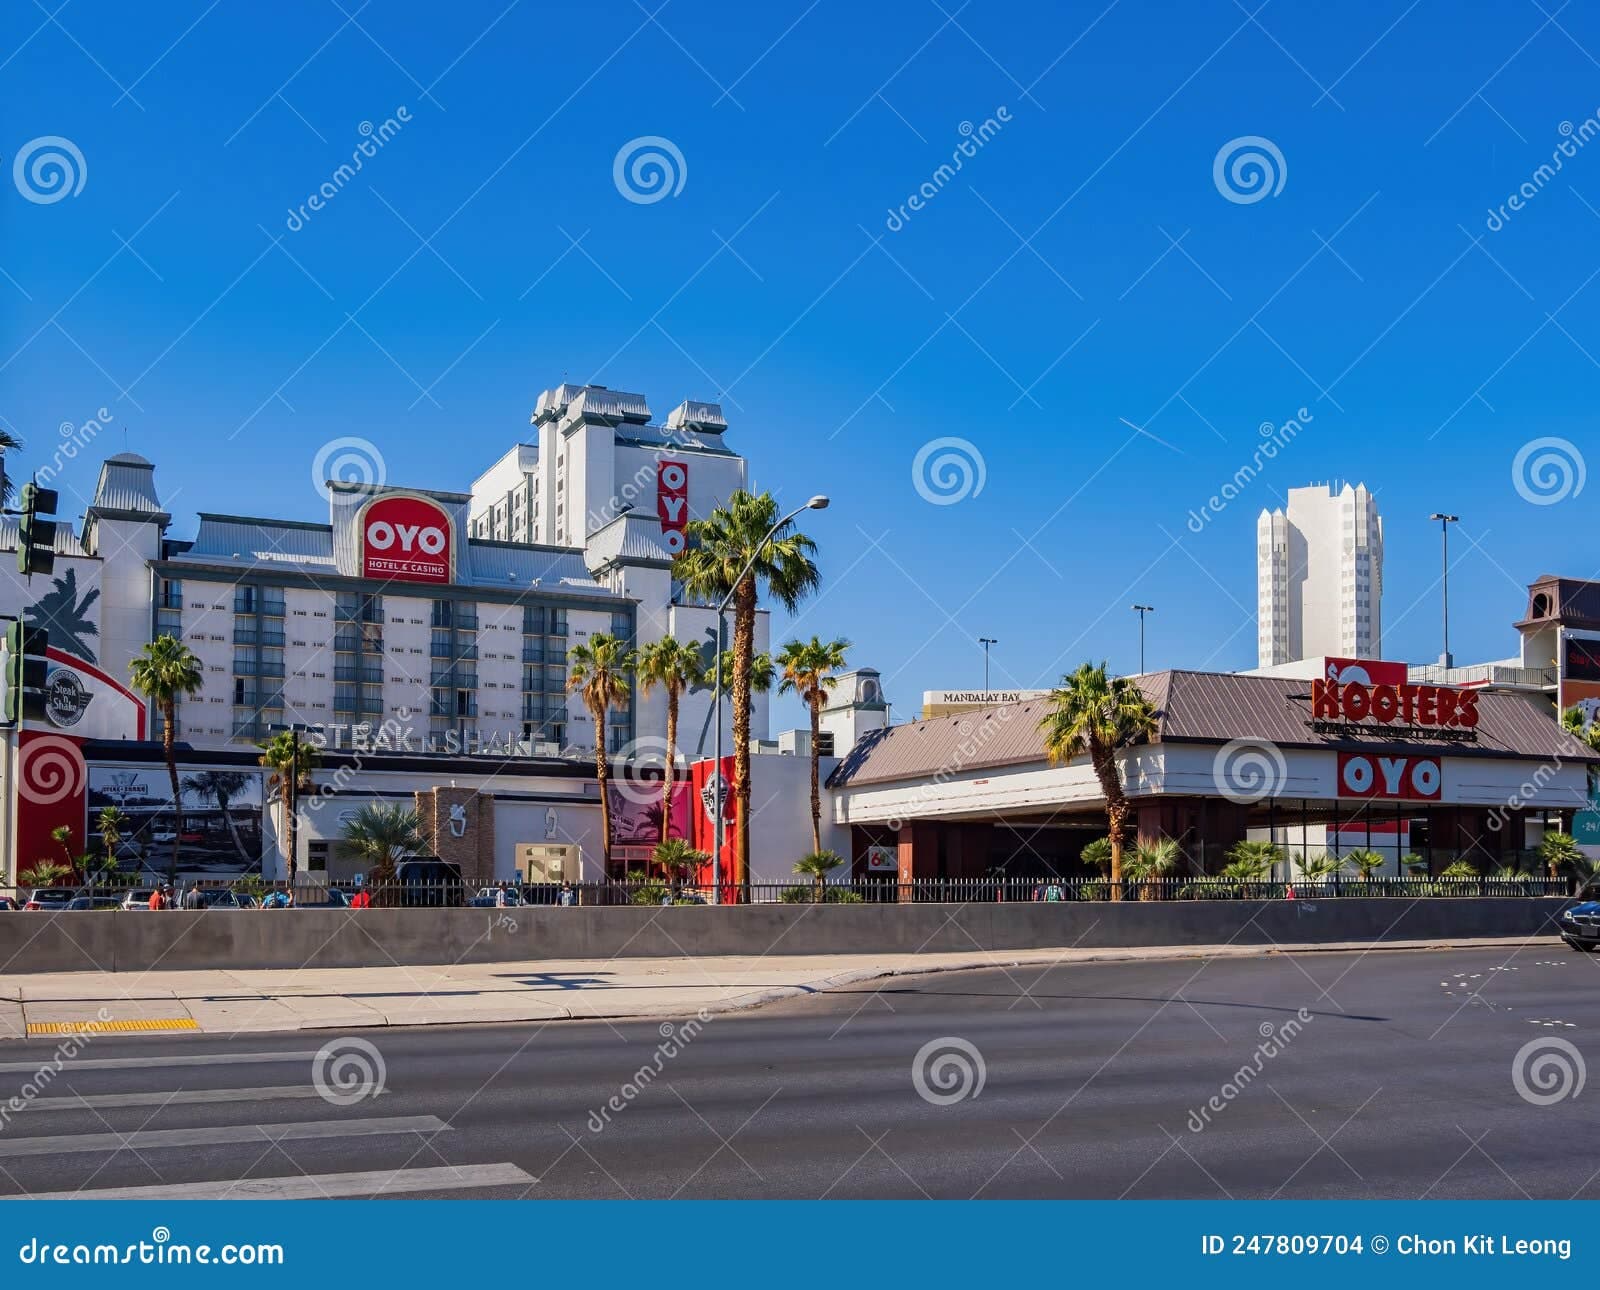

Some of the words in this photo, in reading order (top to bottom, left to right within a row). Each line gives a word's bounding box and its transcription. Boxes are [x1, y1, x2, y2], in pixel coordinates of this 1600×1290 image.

[662, 465, 685, 555] OYO
[367, 521, 446, 555] OYO
[369, 561, 398, 570] HOTEL
[400, 563, 408, 571] &
[411, 564, 444, 574] CASINO
[53, 698, 77, 712] Shake
[54, 682, 77, 696] Steak
[943, 693, 1000, 702] MANDALAY
[1001, 693, 1020, 702] BAY
[1312, 679, 1479, 728] HOOTERS
[309, 722, 414, 752] STEAK
[445, 728, 547, 758] SHAKE
[1343, 756, 1441, 796] OYO
